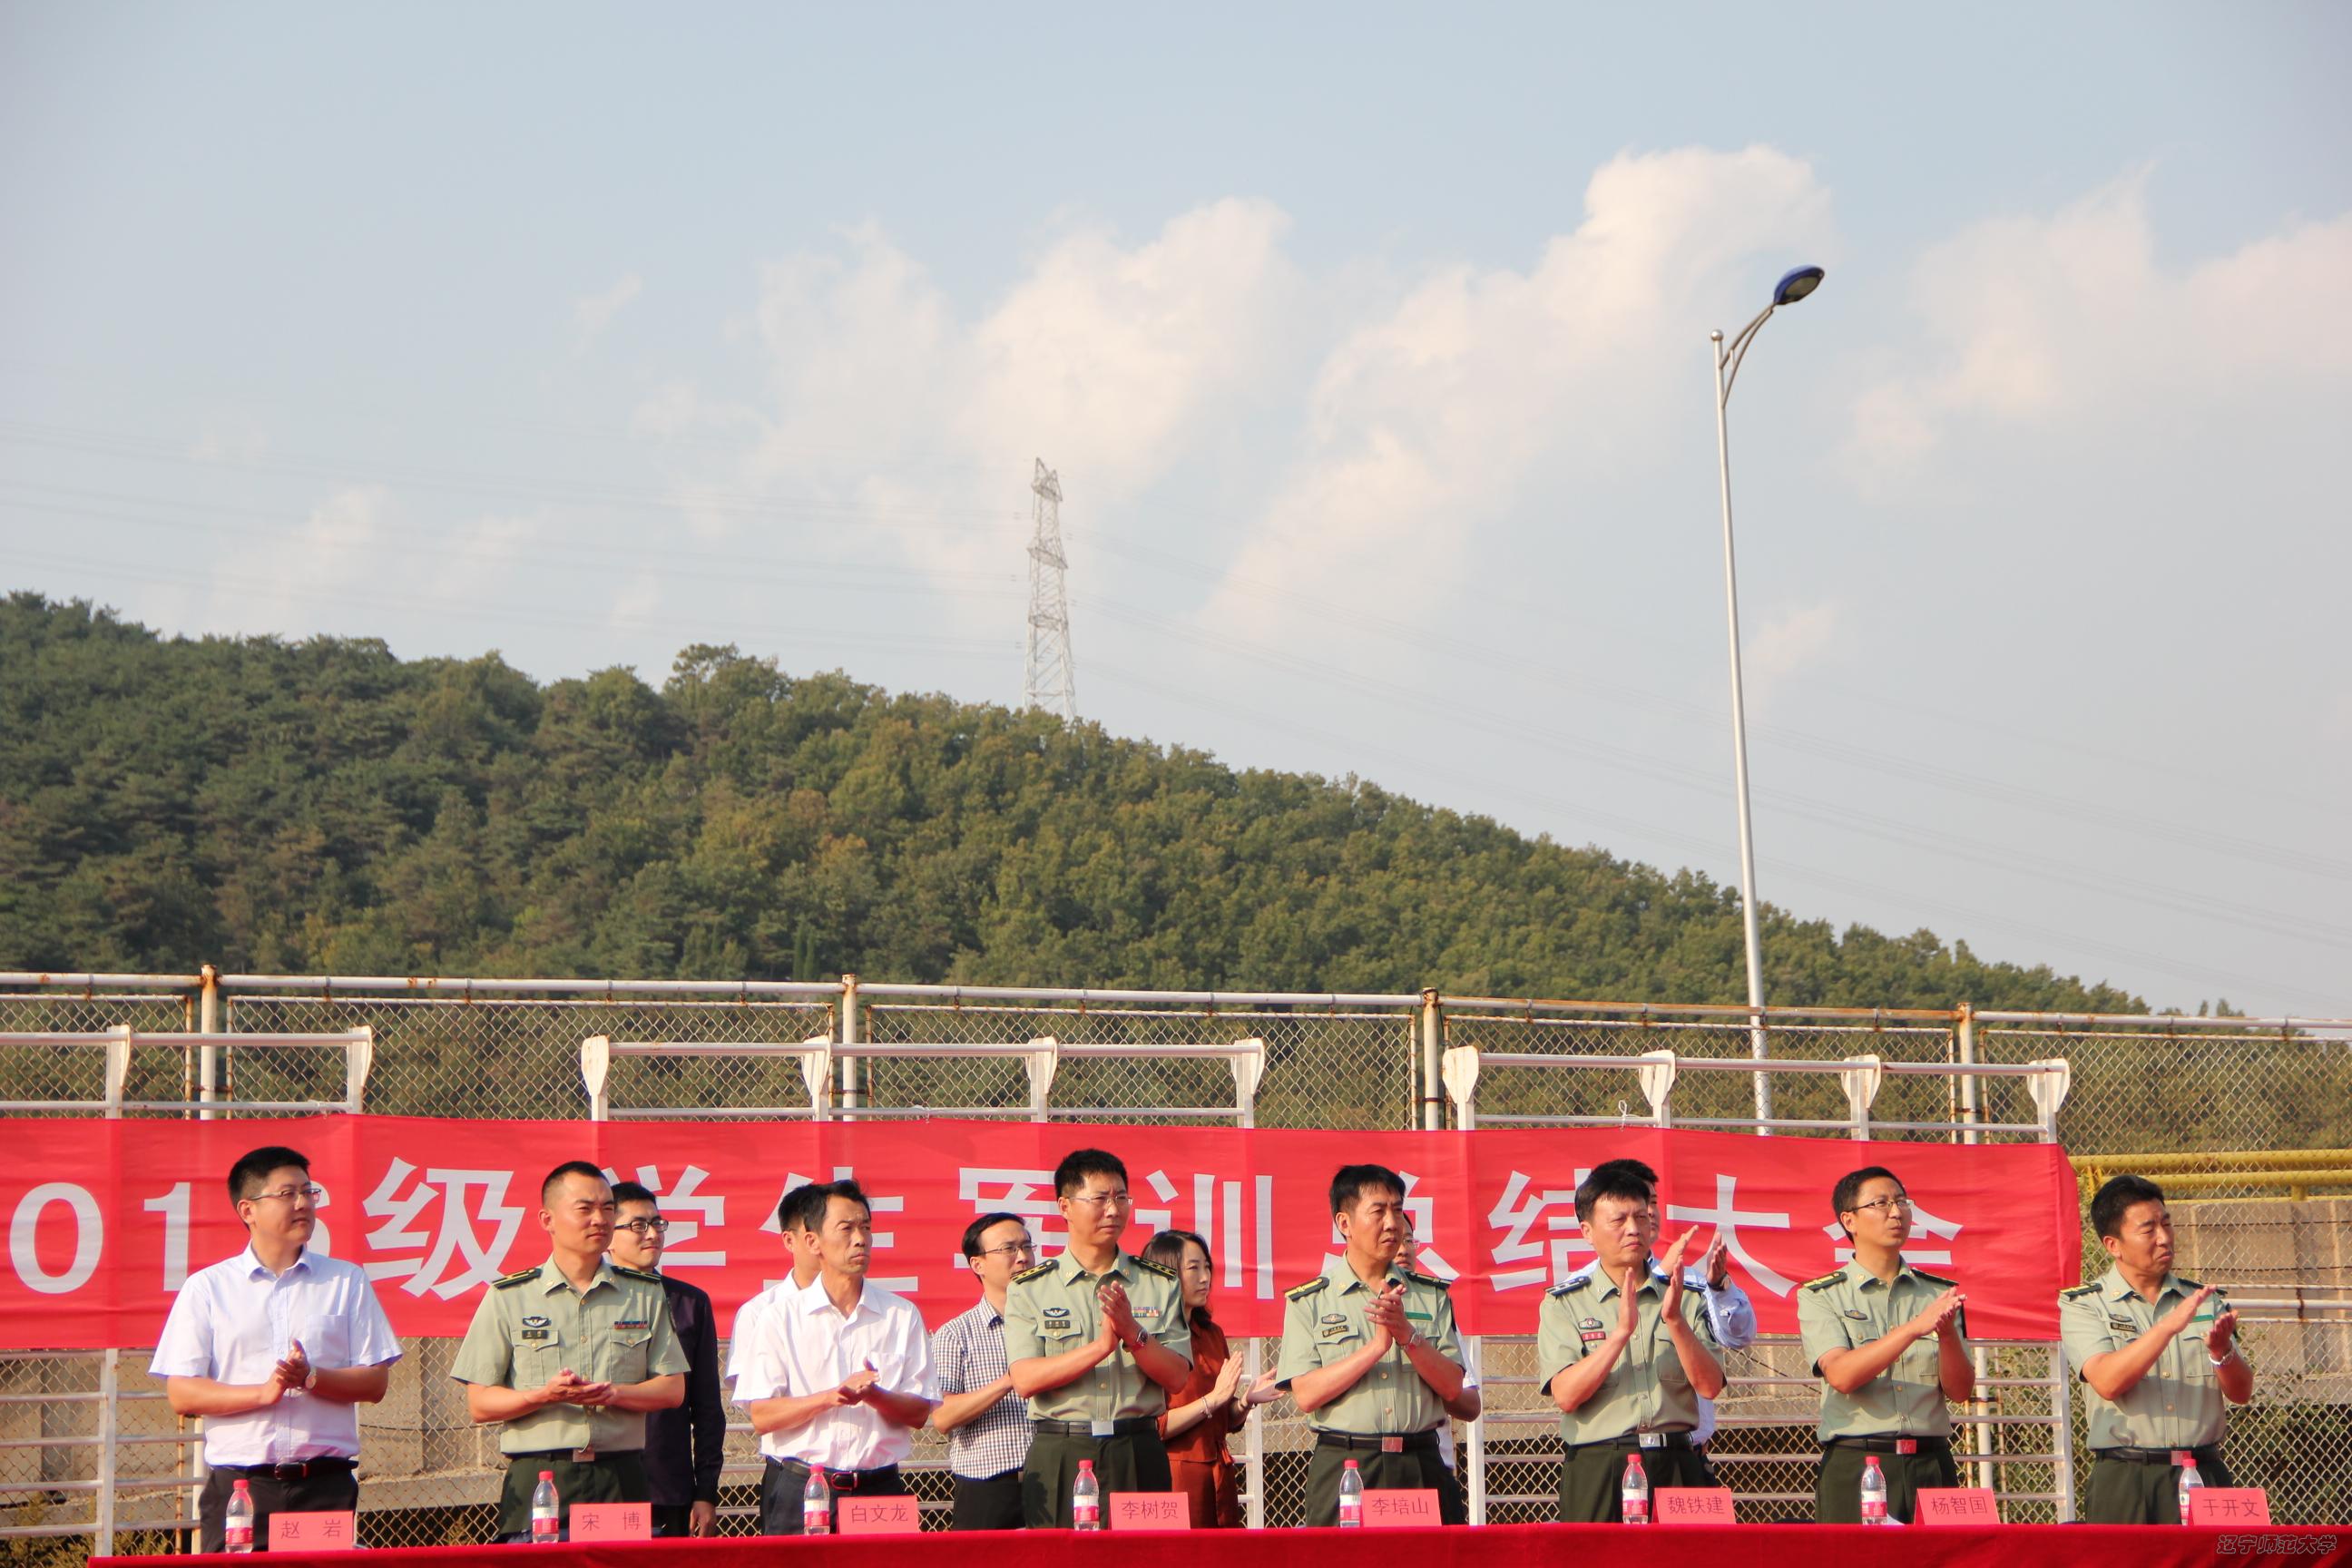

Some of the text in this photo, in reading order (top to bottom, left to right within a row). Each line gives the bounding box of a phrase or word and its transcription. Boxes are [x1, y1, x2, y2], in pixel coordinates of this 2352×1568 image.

[851, 1504, 908, 1524] 白文龙
[1122, 1499, 1178, 1520] 李树贺
[1372, 1497, 1429, 1516] 李培山
[1668, 1495, 1725, 1514] 魏铁建
[1931, 1496, 1987, 1514] 杨智国
[2202, 1498, 2260, 1517] 于开文
[280, 1519, 342, 1539] 赵岩
[582, 1511, 642, 1532] 宋博
